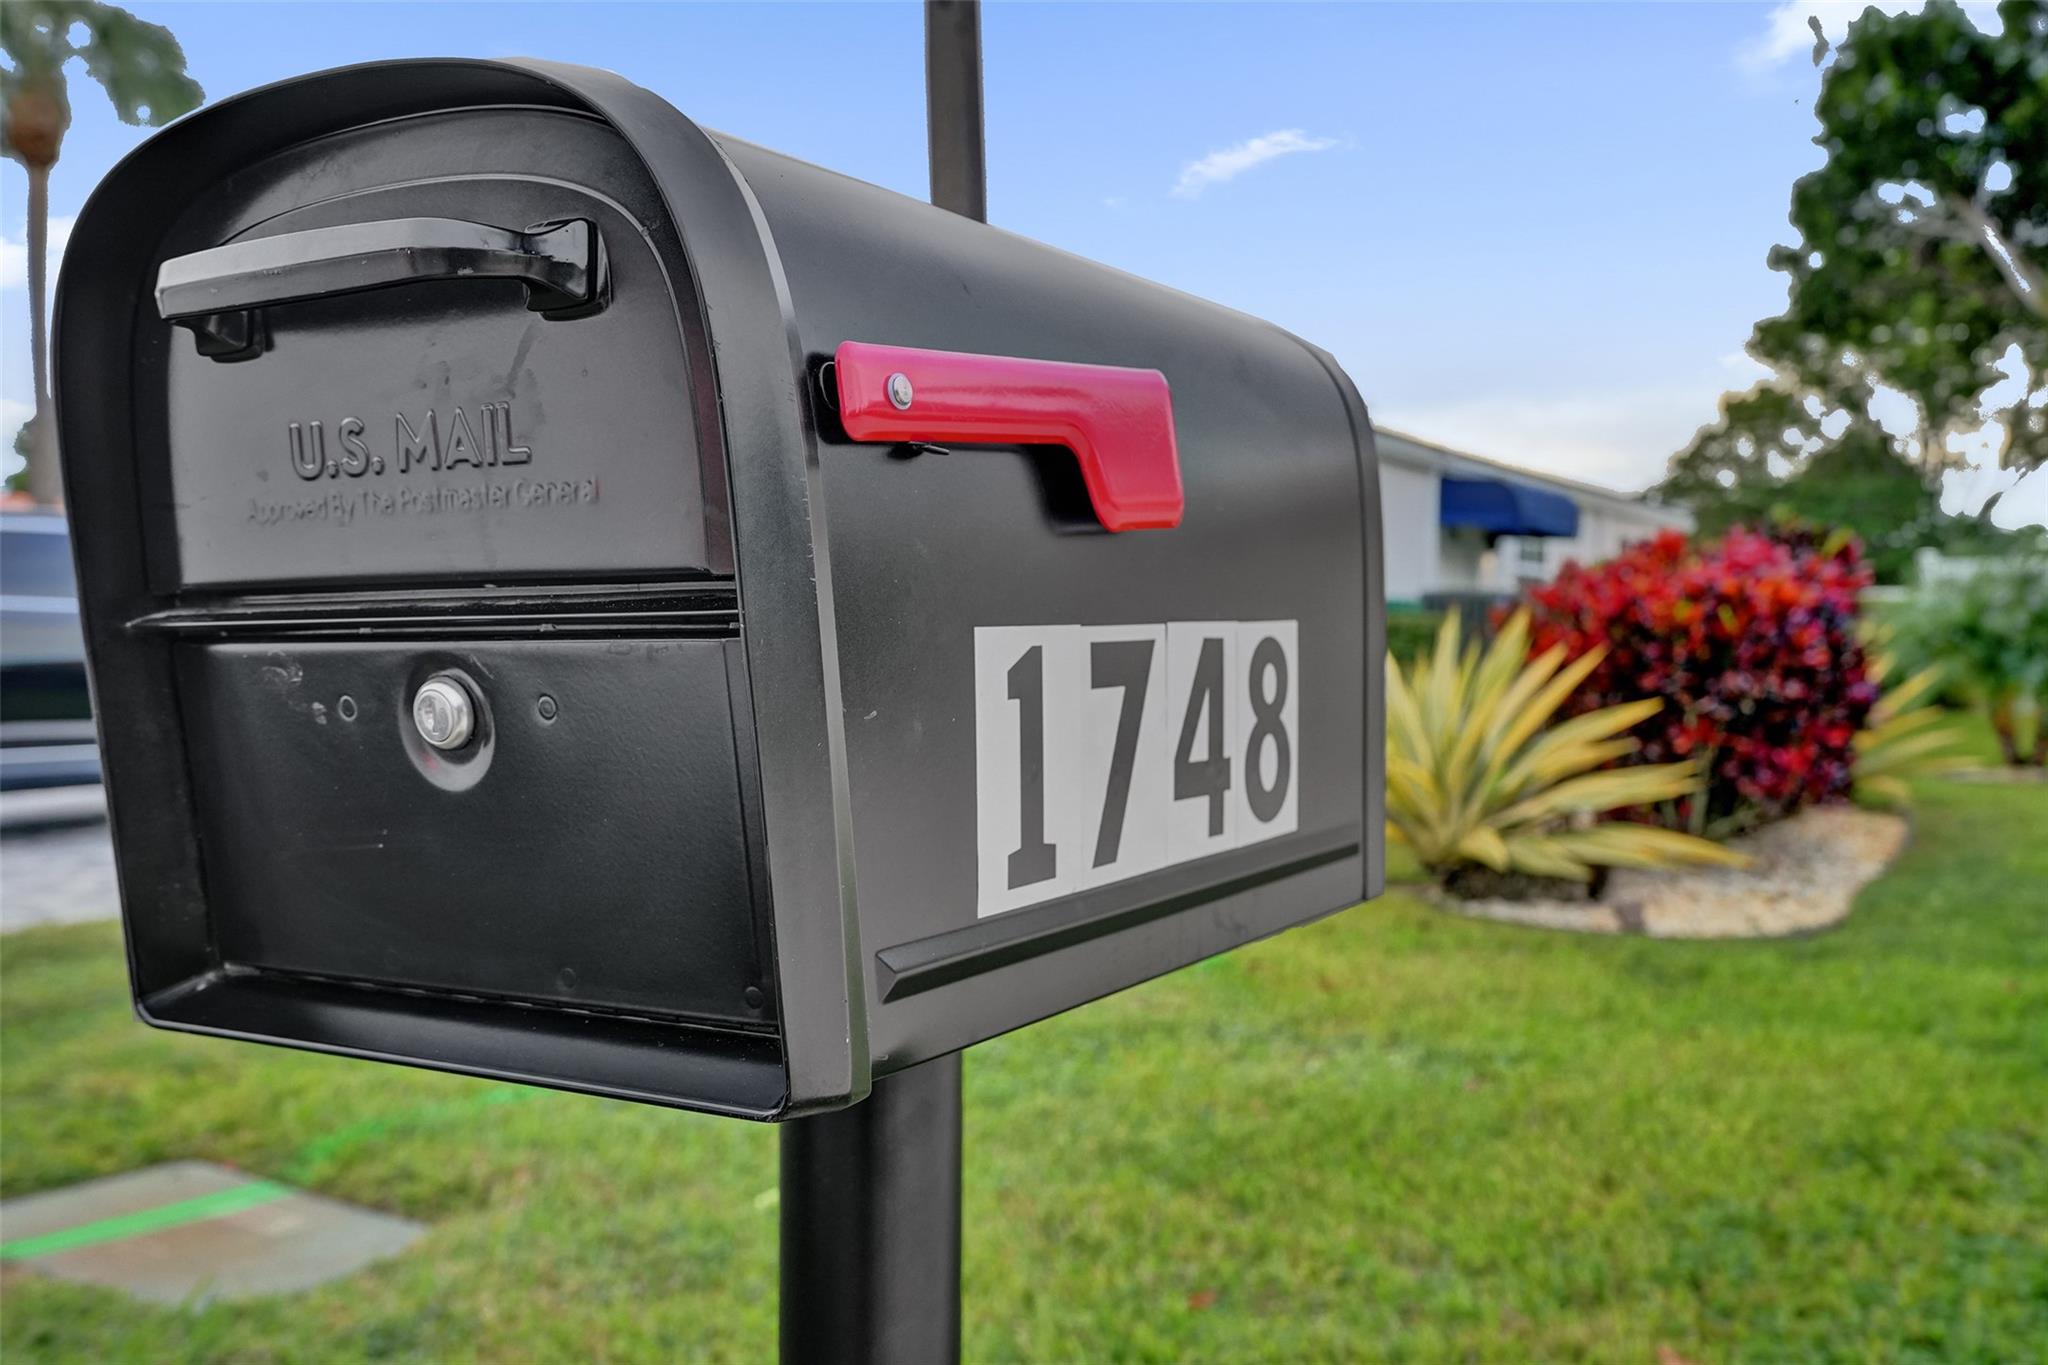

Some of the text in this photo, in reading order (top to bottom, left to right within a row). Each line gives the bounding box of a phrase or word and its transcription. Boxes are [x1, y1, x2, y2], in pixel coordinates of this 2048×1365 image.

[288, 401, 532, 481] U.S. MAIL
[247, 474, 601, 526] Approved By The Postmaster General
[1007, 636, 1291, 890] 1748
